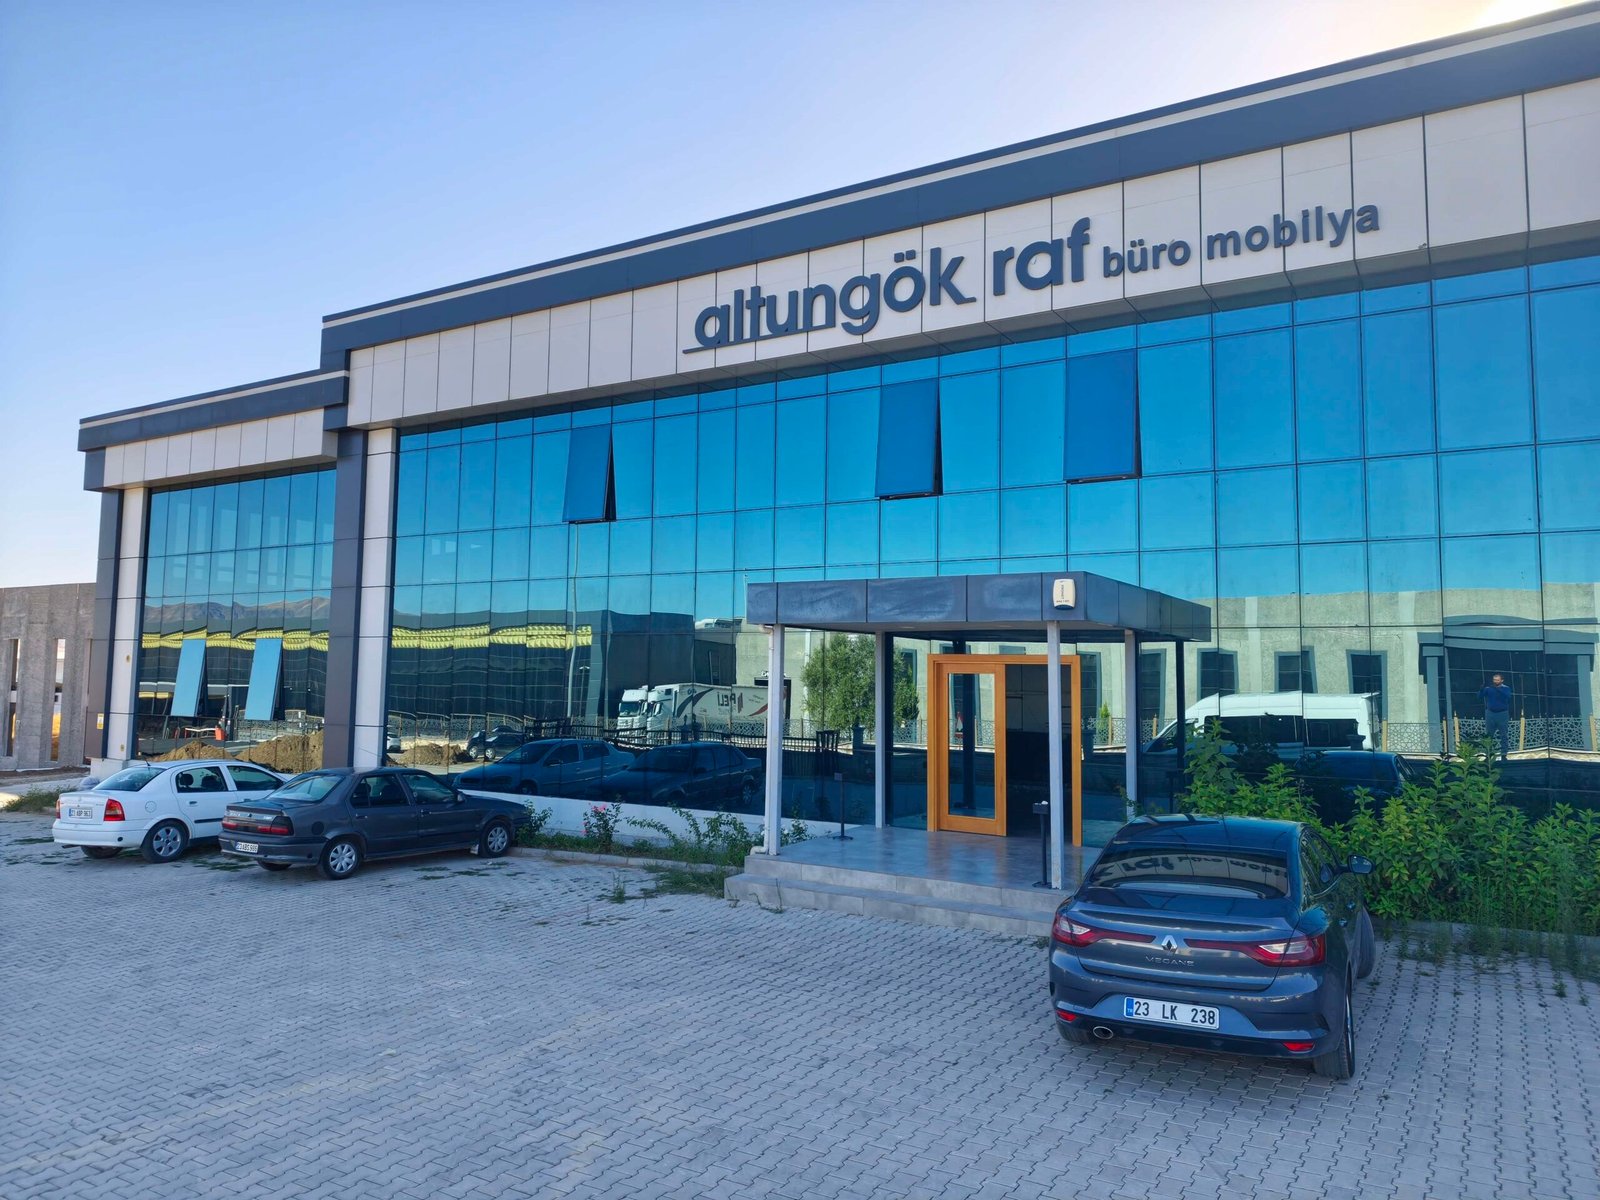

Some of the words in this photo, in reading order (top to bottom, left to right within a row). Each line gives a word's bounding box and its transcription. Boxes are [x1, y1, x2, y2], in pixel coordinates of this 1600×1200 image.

[683, 247, 976, 353] altungök
[993, 217, 1090, 296] raf
[1103, 239, 1191, 278] büro
[1206, 204, 1379, 260] mobilya
[1134, 1001, 1150, 1017] 23
[1162, 1004, 1178, 1021] LK
[1190, 1008, 1216, 1025] 238
